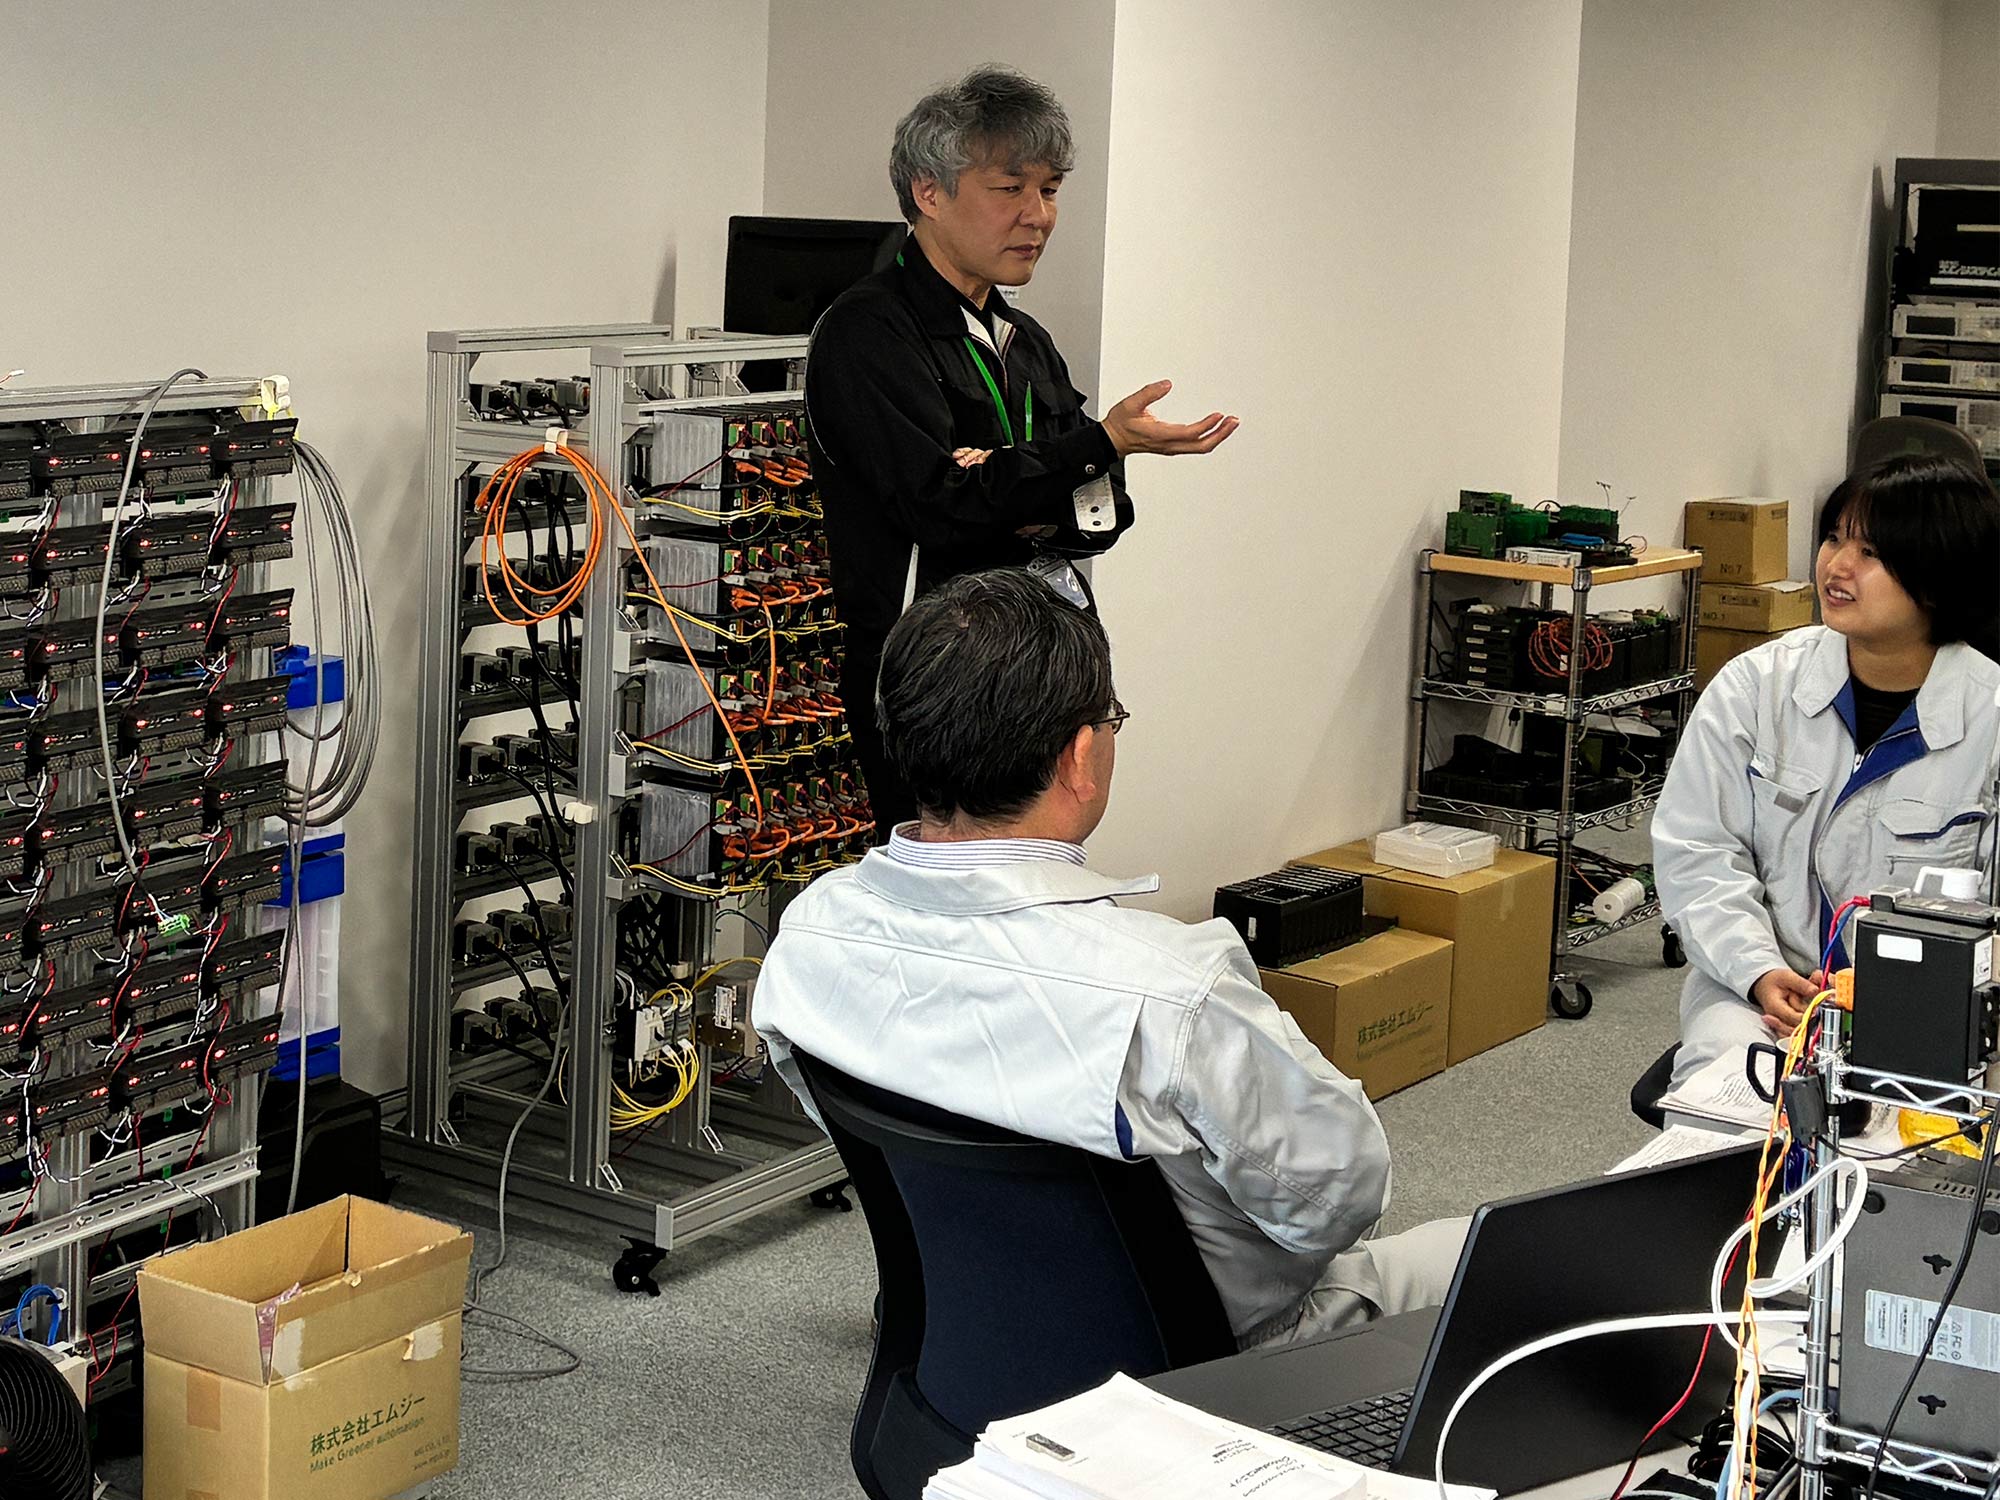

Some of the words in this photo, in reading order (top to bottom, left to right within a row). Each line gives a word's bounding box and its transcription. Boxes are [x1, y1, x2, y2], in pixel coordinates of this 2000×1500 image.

[310, 1393, 425, 1457] 株式会社エムジー
